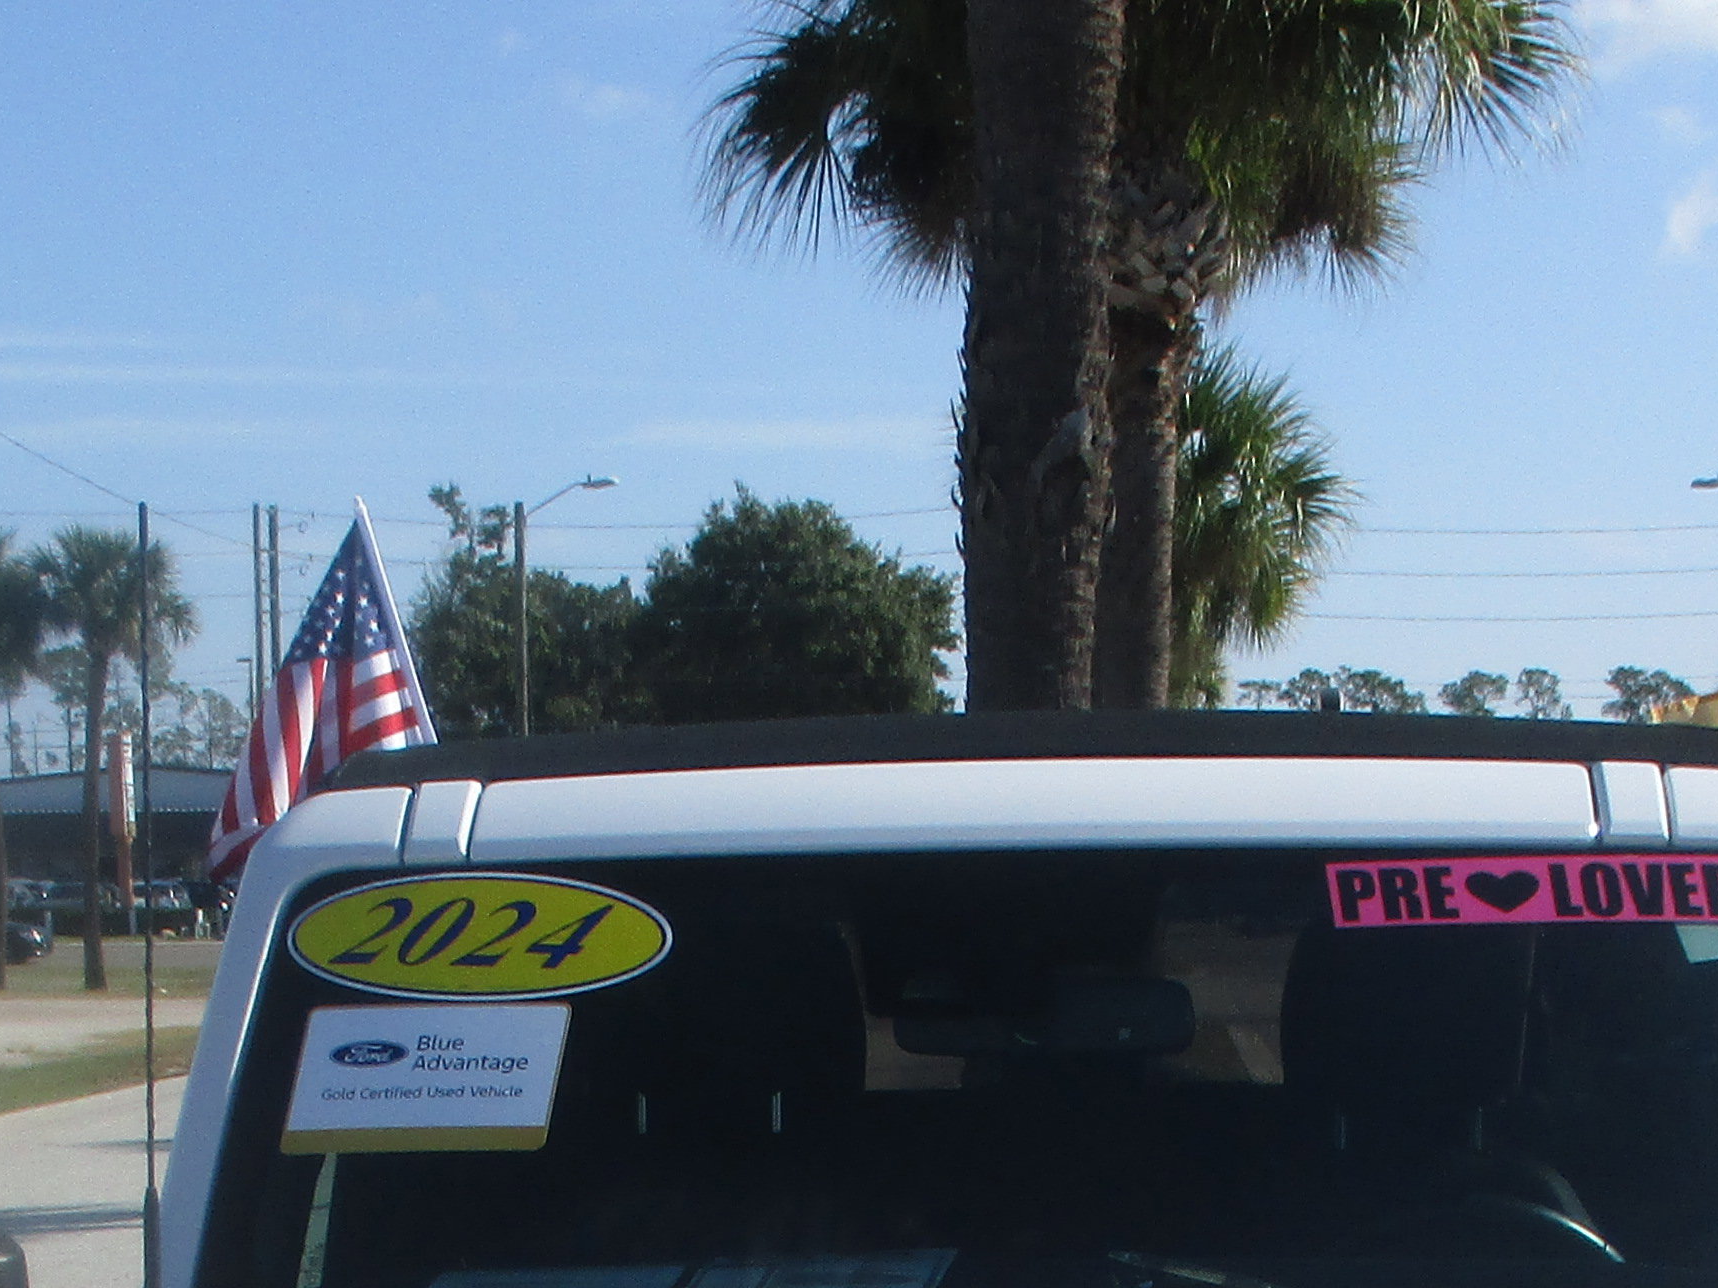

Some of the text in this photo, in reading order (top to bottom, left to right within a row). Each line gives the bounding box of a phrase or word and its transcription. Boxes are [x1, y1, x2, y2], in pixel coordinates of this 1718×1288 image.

[1335, 866, 1460, 922] PRE
[329, 898, 614, 969] 2024
[416, 1034, 465, 1051] Blue
[342, 1044, 396, 1064] Ford
[412, 1054, 529, 1074] Advantage
[321, 1084, 523, 1101] Gold Certified Used Vehicle
